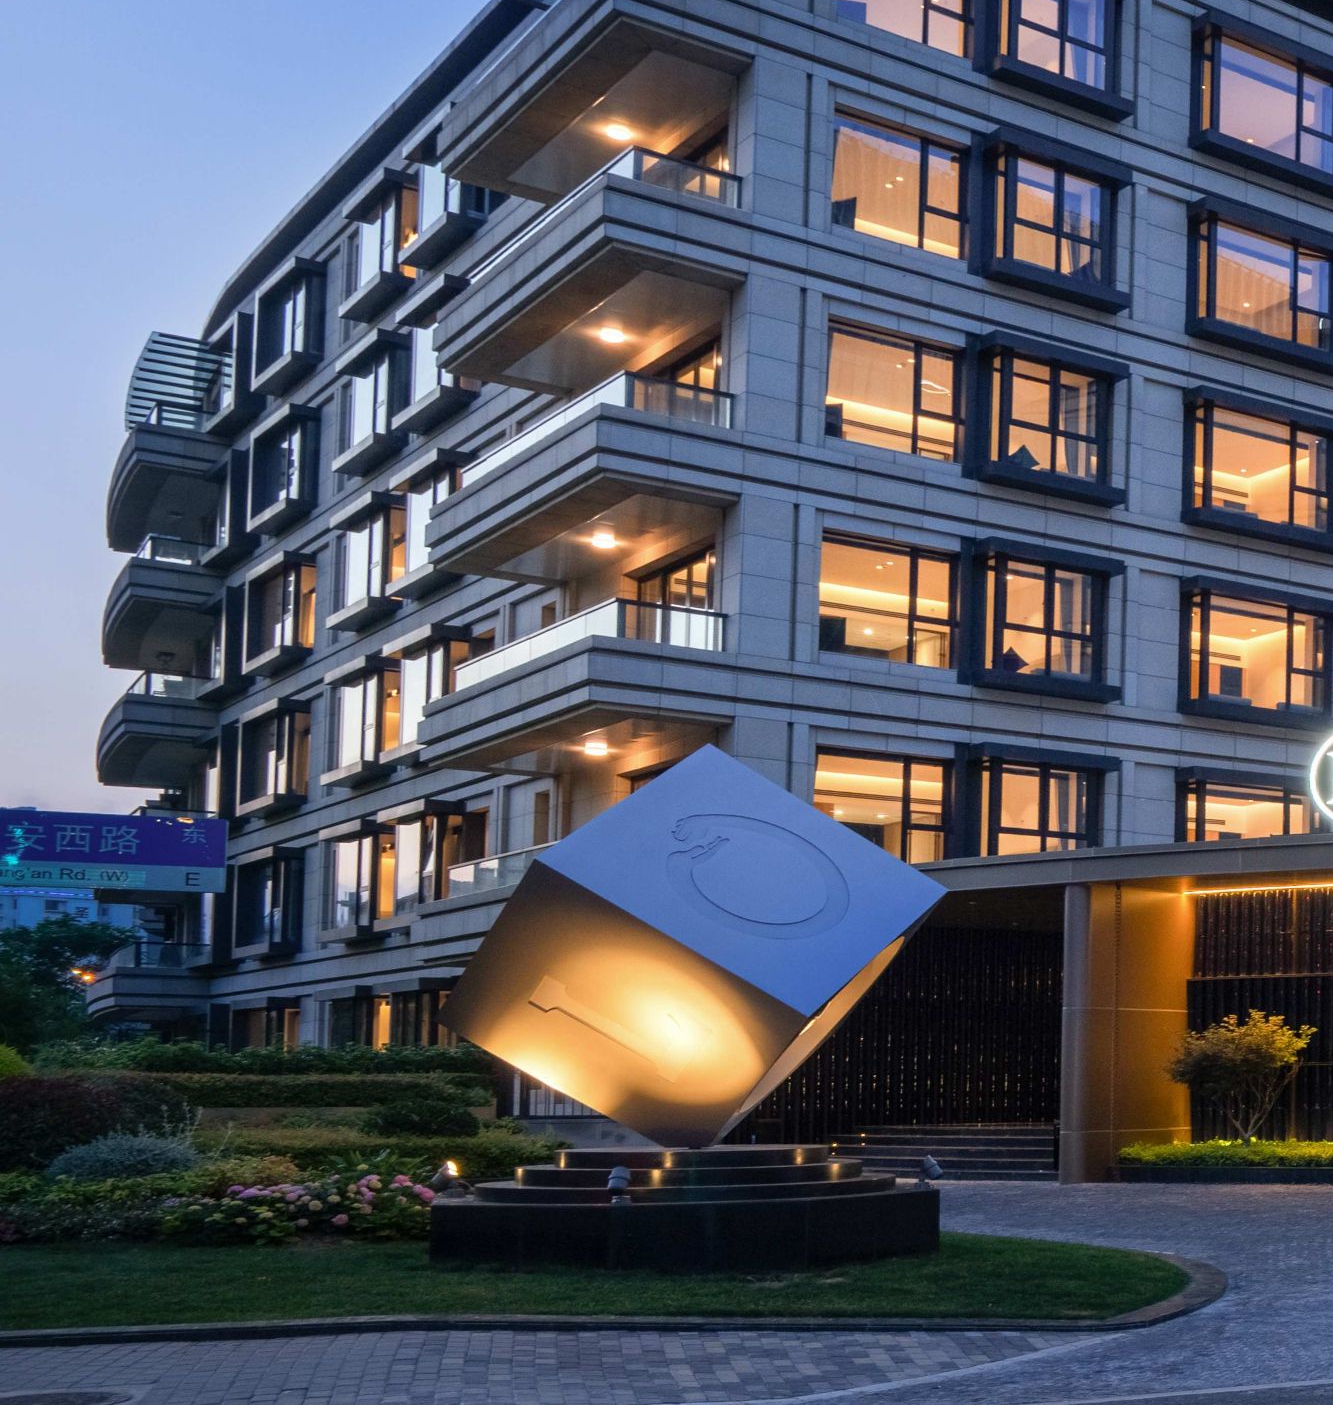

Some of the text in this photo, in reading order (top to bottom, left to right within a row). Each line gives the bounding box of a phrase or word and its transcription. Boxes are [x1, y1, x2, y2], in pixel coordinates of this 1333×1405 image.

[5, 821, 141, 855] 安西路
[181, 826, 208, 844] 东
[60, 867, 91, 881] Rd.
[100, 869, 129, 883] (W)
[185, 872, 201, 887] E
